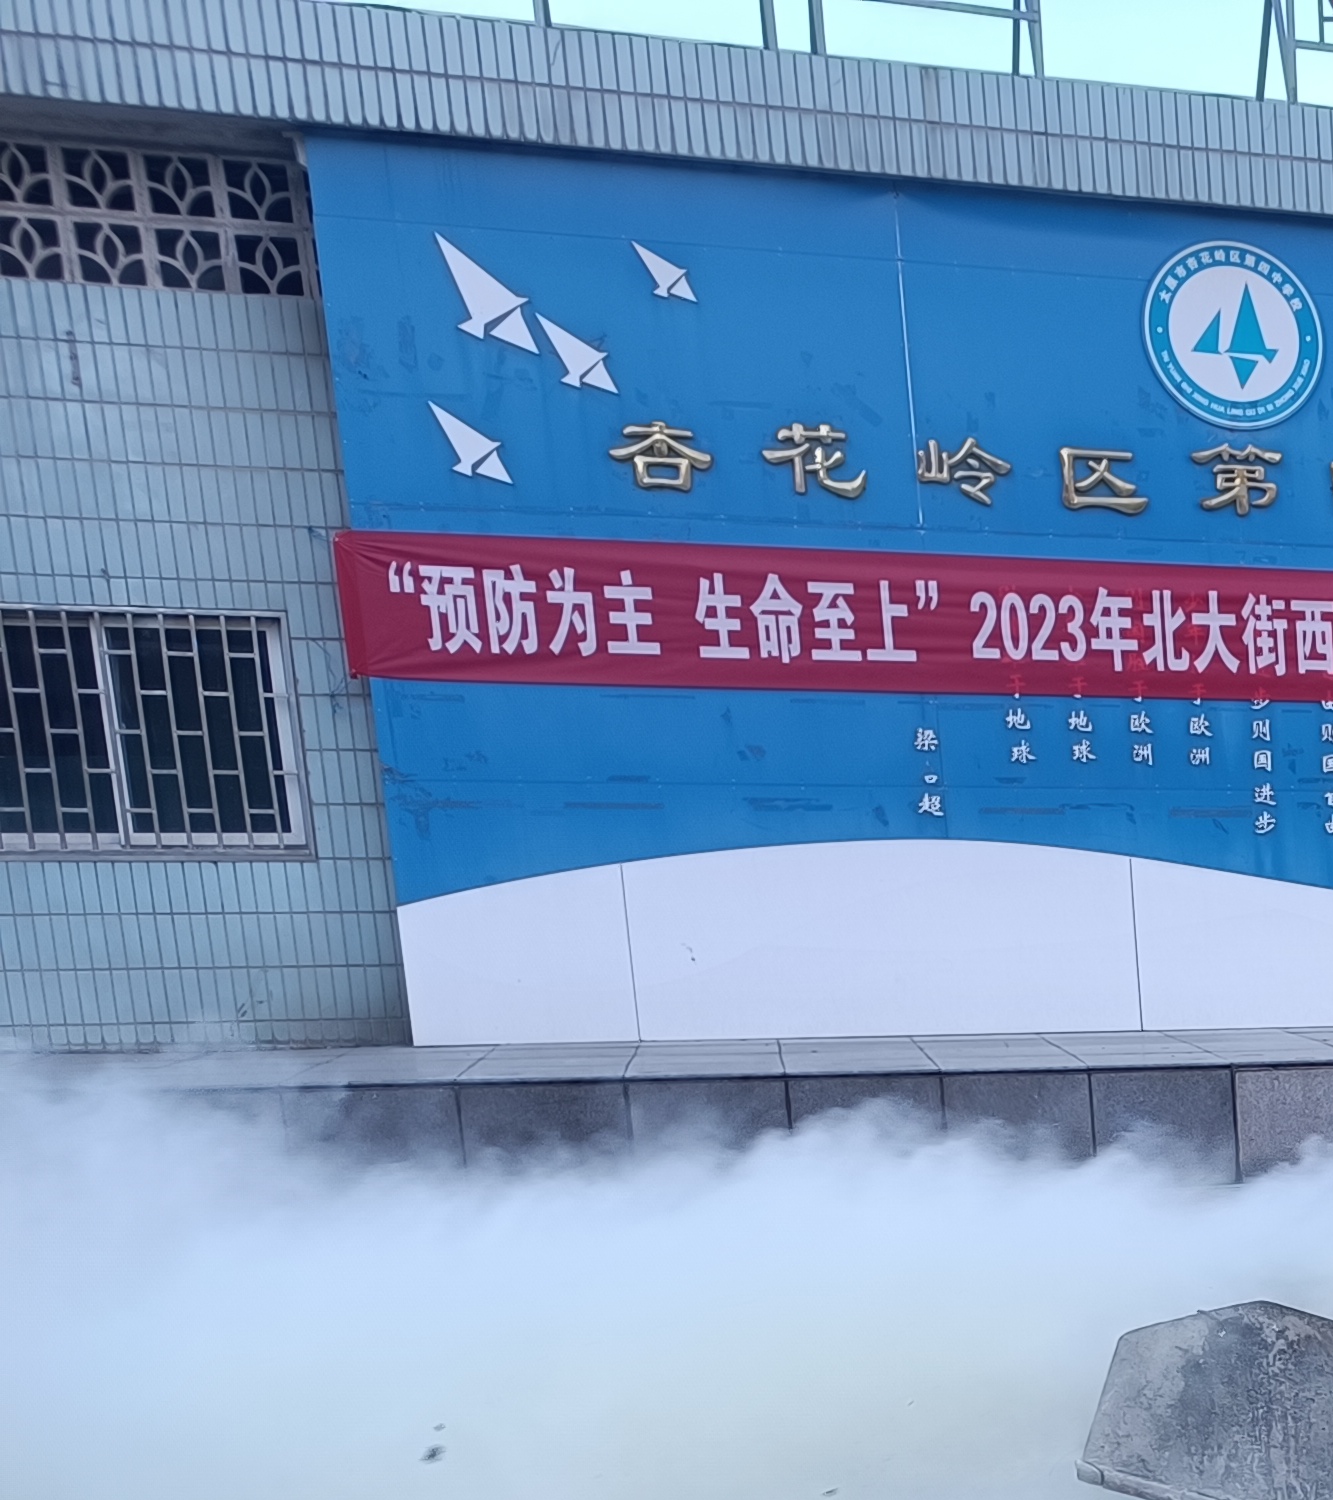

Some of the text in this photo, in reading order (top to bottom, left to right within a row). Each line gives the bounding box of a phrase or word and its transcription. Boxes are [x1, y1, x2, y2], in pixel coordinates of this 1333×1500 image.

[388, 560, 661, 656] “预防为主
[695, 572, 938, 664] 生命至上”
[1005, 691, 1036, 763] 地球
[1067, 692, 1096, 763] 地球
[1130, 694, 1154, 765] 欧洲
[1189, 697, 1213, 766] 欧洲
